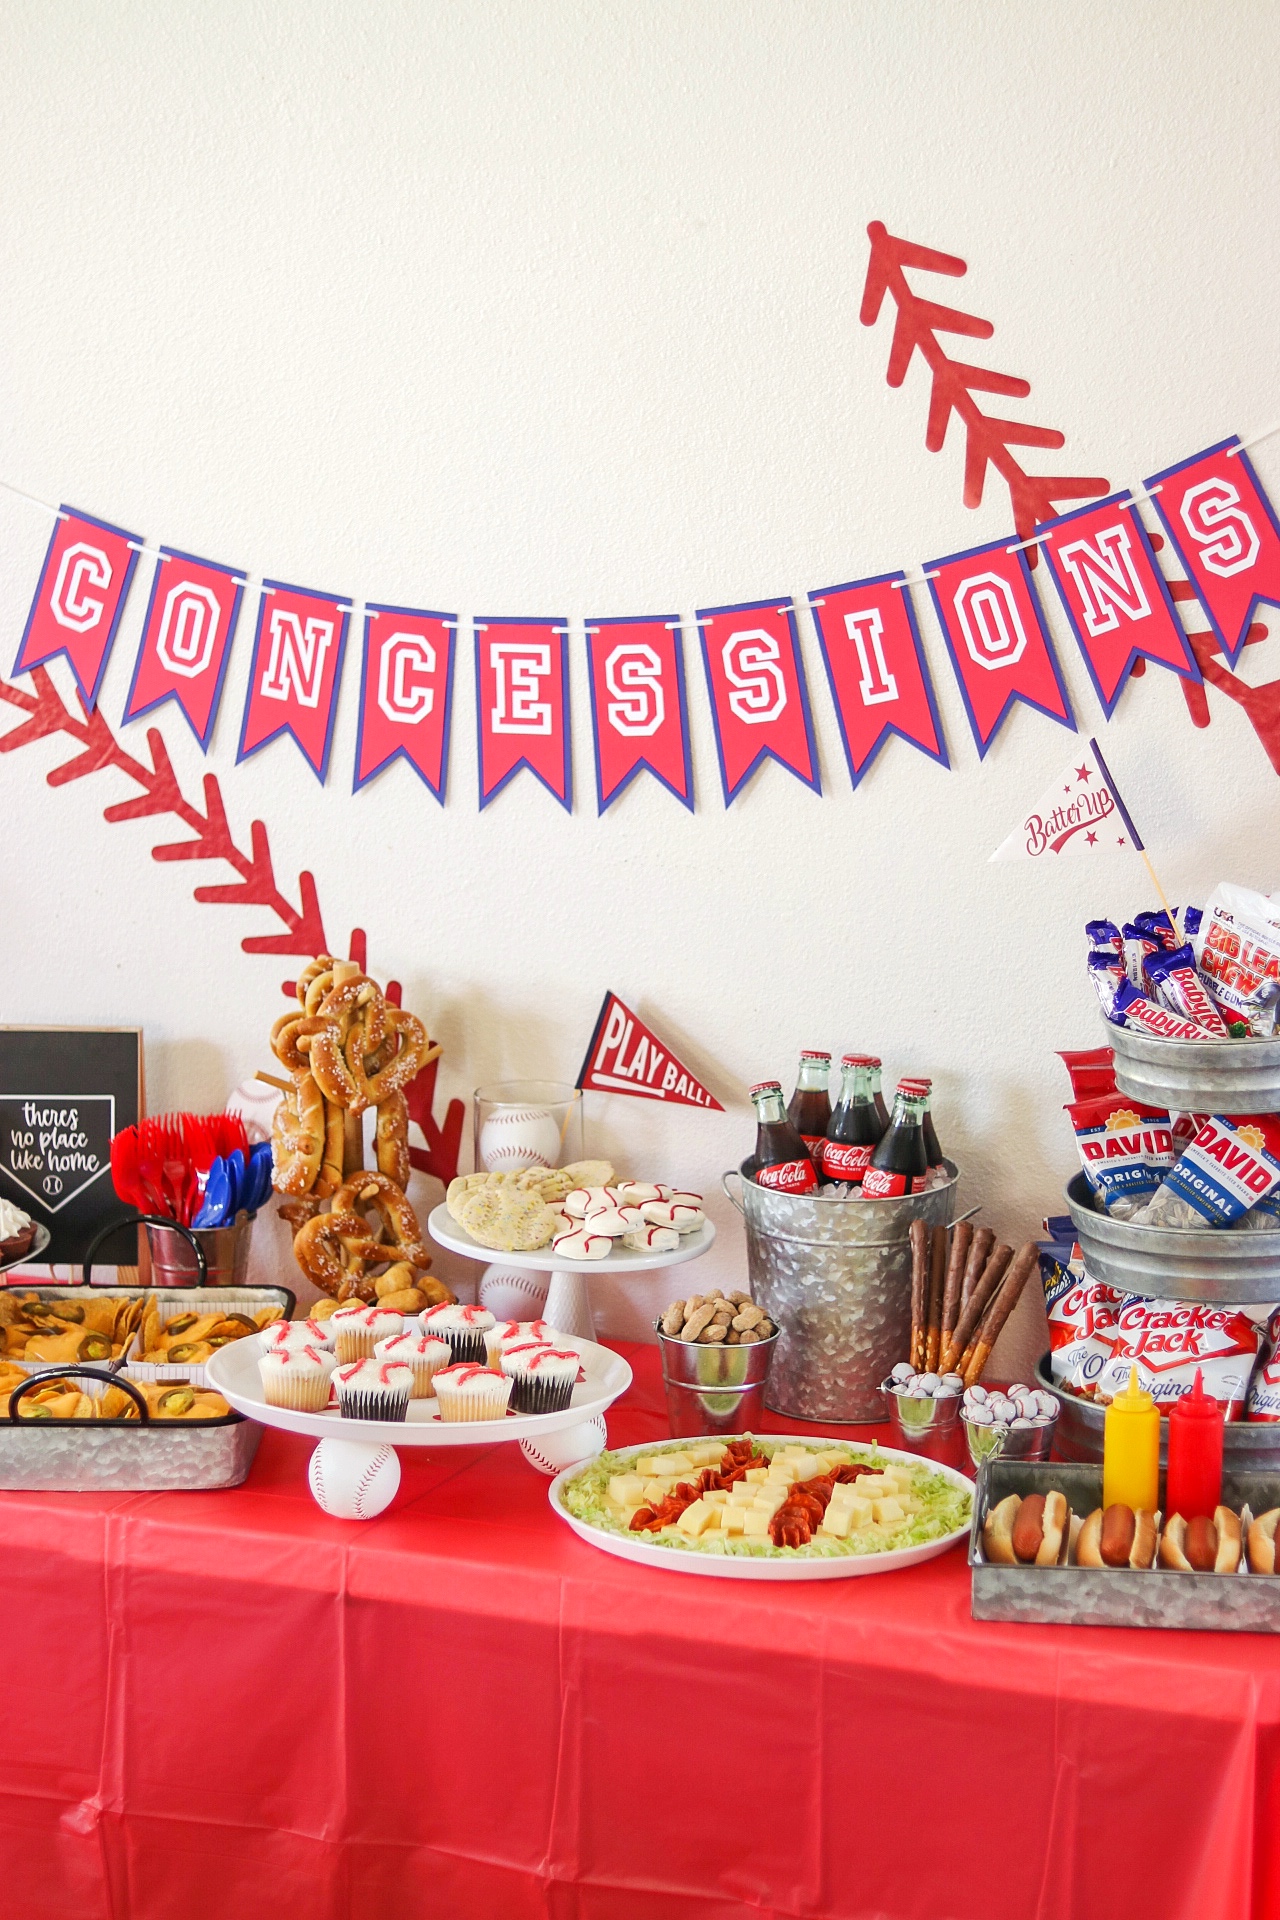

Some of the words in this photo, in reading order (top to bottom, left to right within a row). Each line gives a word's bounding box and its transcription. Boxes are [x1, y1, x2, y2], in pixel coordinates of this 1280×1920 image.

[50, 476, 1261, 737] CONCESSIONS
[1024, 803, 1082, 856] Batter
[1205, 921, 1241, 960] BIG
[1200, 946, 1264, 998] CHEW
[594, 1001, 665, 1085] PLAY
[661, 1061, 712, 1107] BALL!
[21, 1101, 79, 1131] theres
[11, 1129, 35, 1149] no
[39, 1126, 89, 1156] place
[823, 1143, 873, 1167] Coca-Cola
[1081, 1129, 1174, 1161] DAVID
[10, 1149, 44, 1171] like
[48, 1149, 100, 1173] home
[759, 1162, 806, 1187] Coca-Cola
[1192, 1123, 1273, 1194] DAVID
[1173, 1163, 1233, 1217] ORIGINAL
[1062, 1283, 1124, 1317] Crac
[1123, 1328, 1204, 1358] Jack
